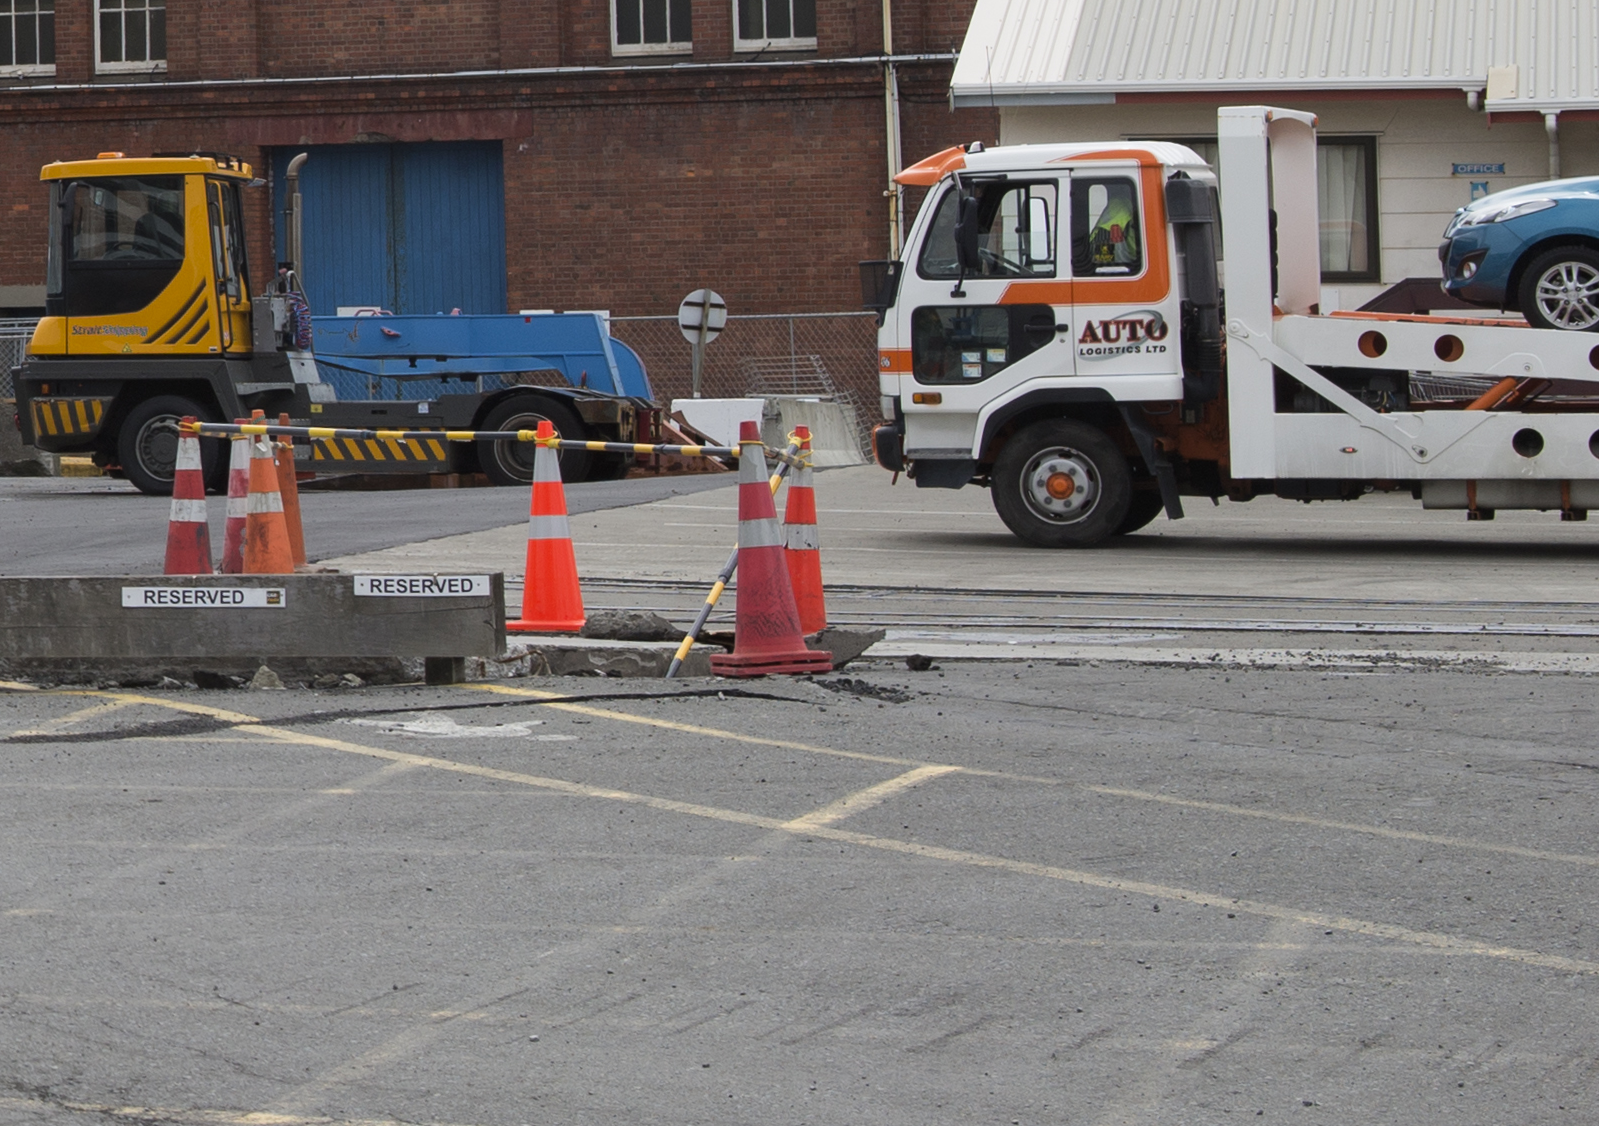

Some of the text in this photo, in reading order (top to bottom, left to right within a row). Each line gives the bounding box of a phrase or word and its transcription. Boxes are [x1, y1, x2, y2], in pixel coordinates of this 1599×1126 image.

[1458, 164, 1499, 173] OFFICE
[1078, 319, 1169, 344] AUTO
[1079, 345, 1167, 356] LOGISTICS LTD
[370, 579, 474, 594] RESERVED
[144, 589, 245, 605] RESERVED
